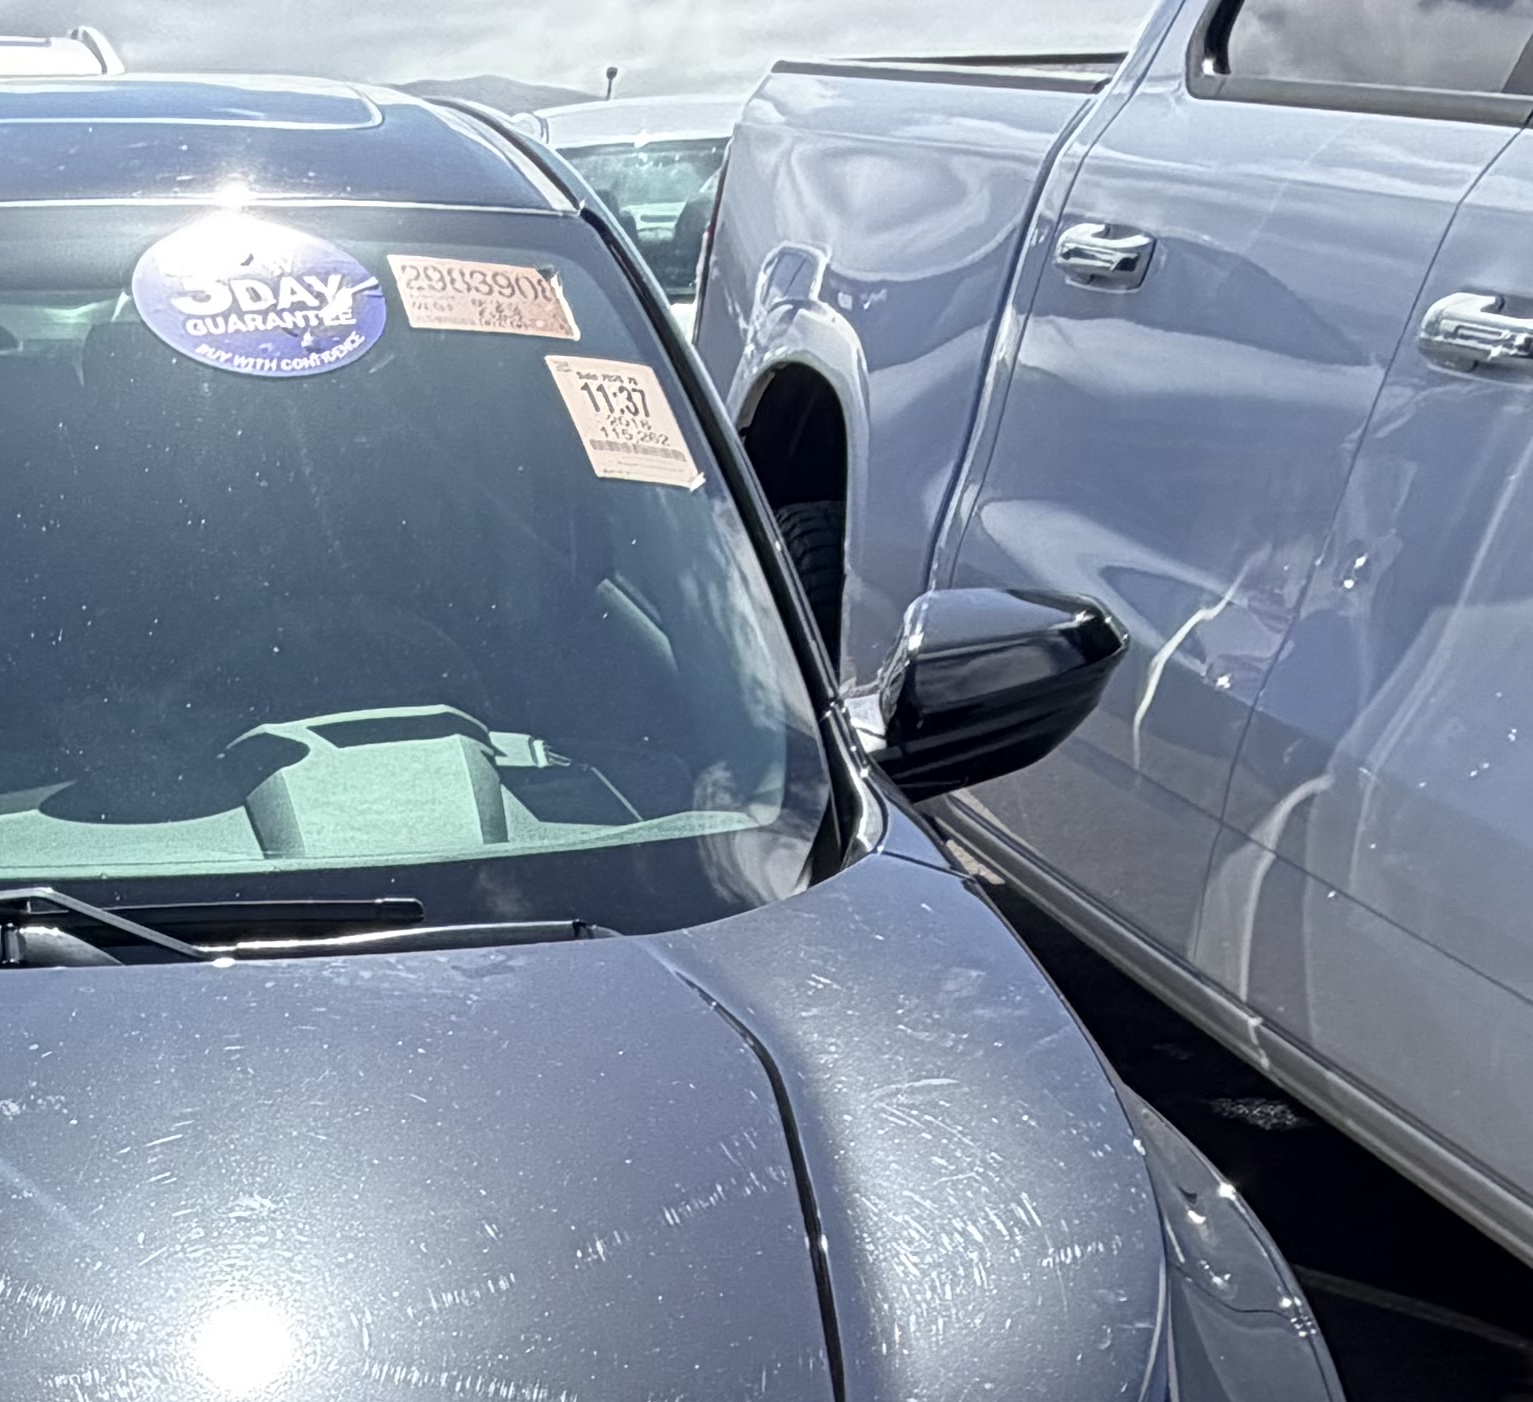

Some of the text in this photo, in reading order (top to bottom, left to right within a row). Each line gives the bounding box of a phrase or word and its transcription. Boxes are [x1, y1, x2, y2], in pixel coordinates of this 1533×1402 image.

[230, 274, 343, 311] DAY
[195, 343, 233, 362] BUY
[233, 354, 277, 371] WITH
[580, 382, 650, 418] 11:37
